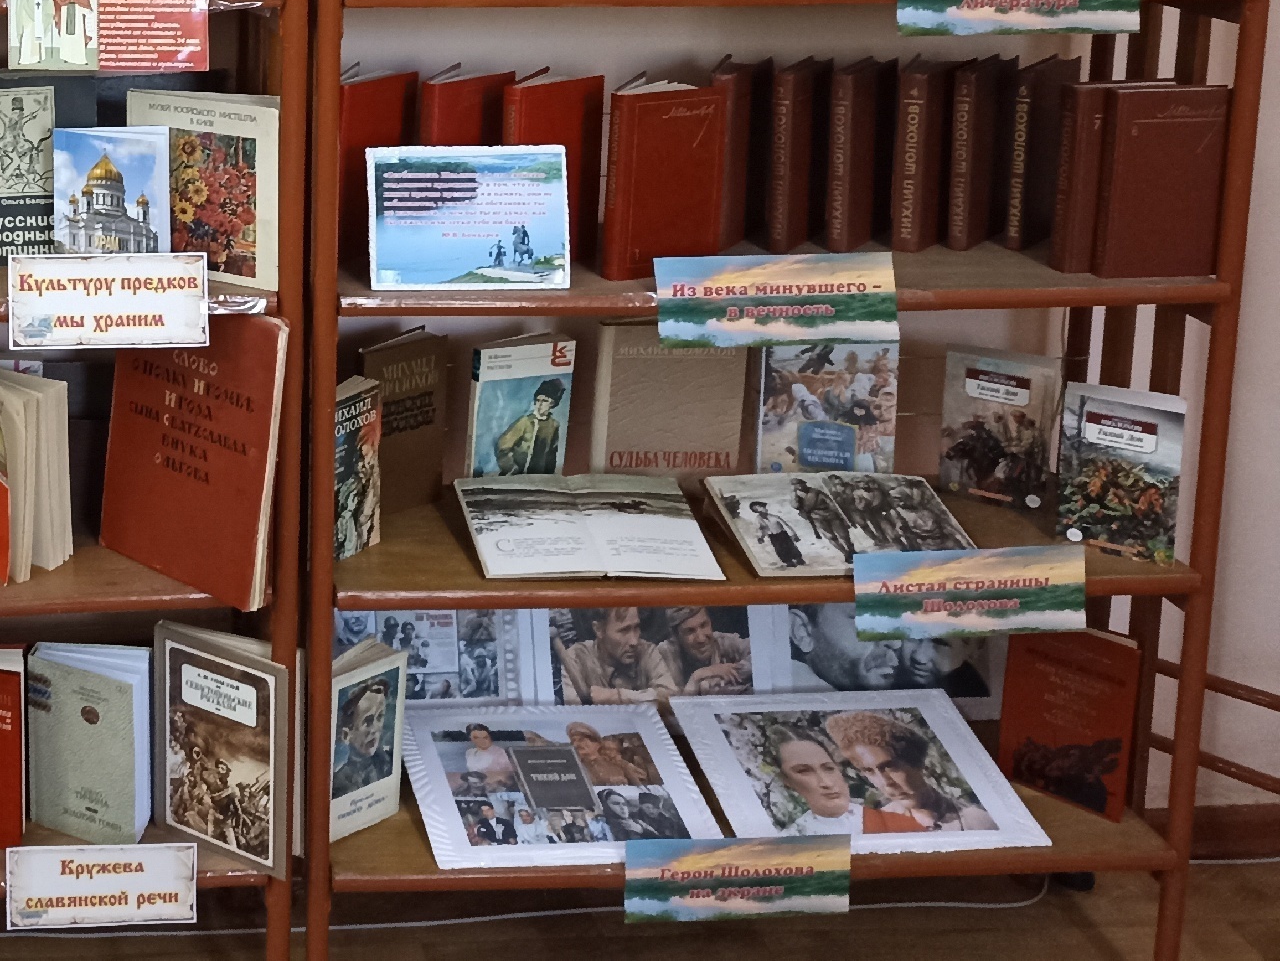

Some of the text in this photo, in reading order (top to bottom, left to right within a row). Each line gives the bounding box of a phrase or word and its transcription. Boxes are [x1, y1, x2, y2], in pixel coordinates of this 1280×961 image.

[904, 103, 920, 176] ШОЛОХОВ
[952, 102, 969, 238] МИХАИЛ ШОЛОХОВ
[1008, 102, 1029, 238] МИХАИЛ ШОЛОХОВ
[900, 179, 914, 239] МИХАИЛ
[18, 273, 199, 298] Культуру предков
[672, 279, 868, 298] Из века минувшего
[53, 312, 165, 332] мы храним
[727, 302, 836, 320] в вечность
[172, 349, 219, 377] СЛОВО
[334, 396, 372, 422] ИХАИЛ
[334, 410, 378, 438] ОЛОХОВ
[609, 450, 731, 470] СУДЬБА ЧЕЛОВЕКА
[877, 575, 1050, 594] Листая страницы
[923, 596, 1020, 614] Шолохова
[60, 858, 146, 879] Кружева
[659, 864, 814, 883] Герои Шолохова
[25, 889, 180, 912] славянской речи
[688, 885, 786, 902] на экране
